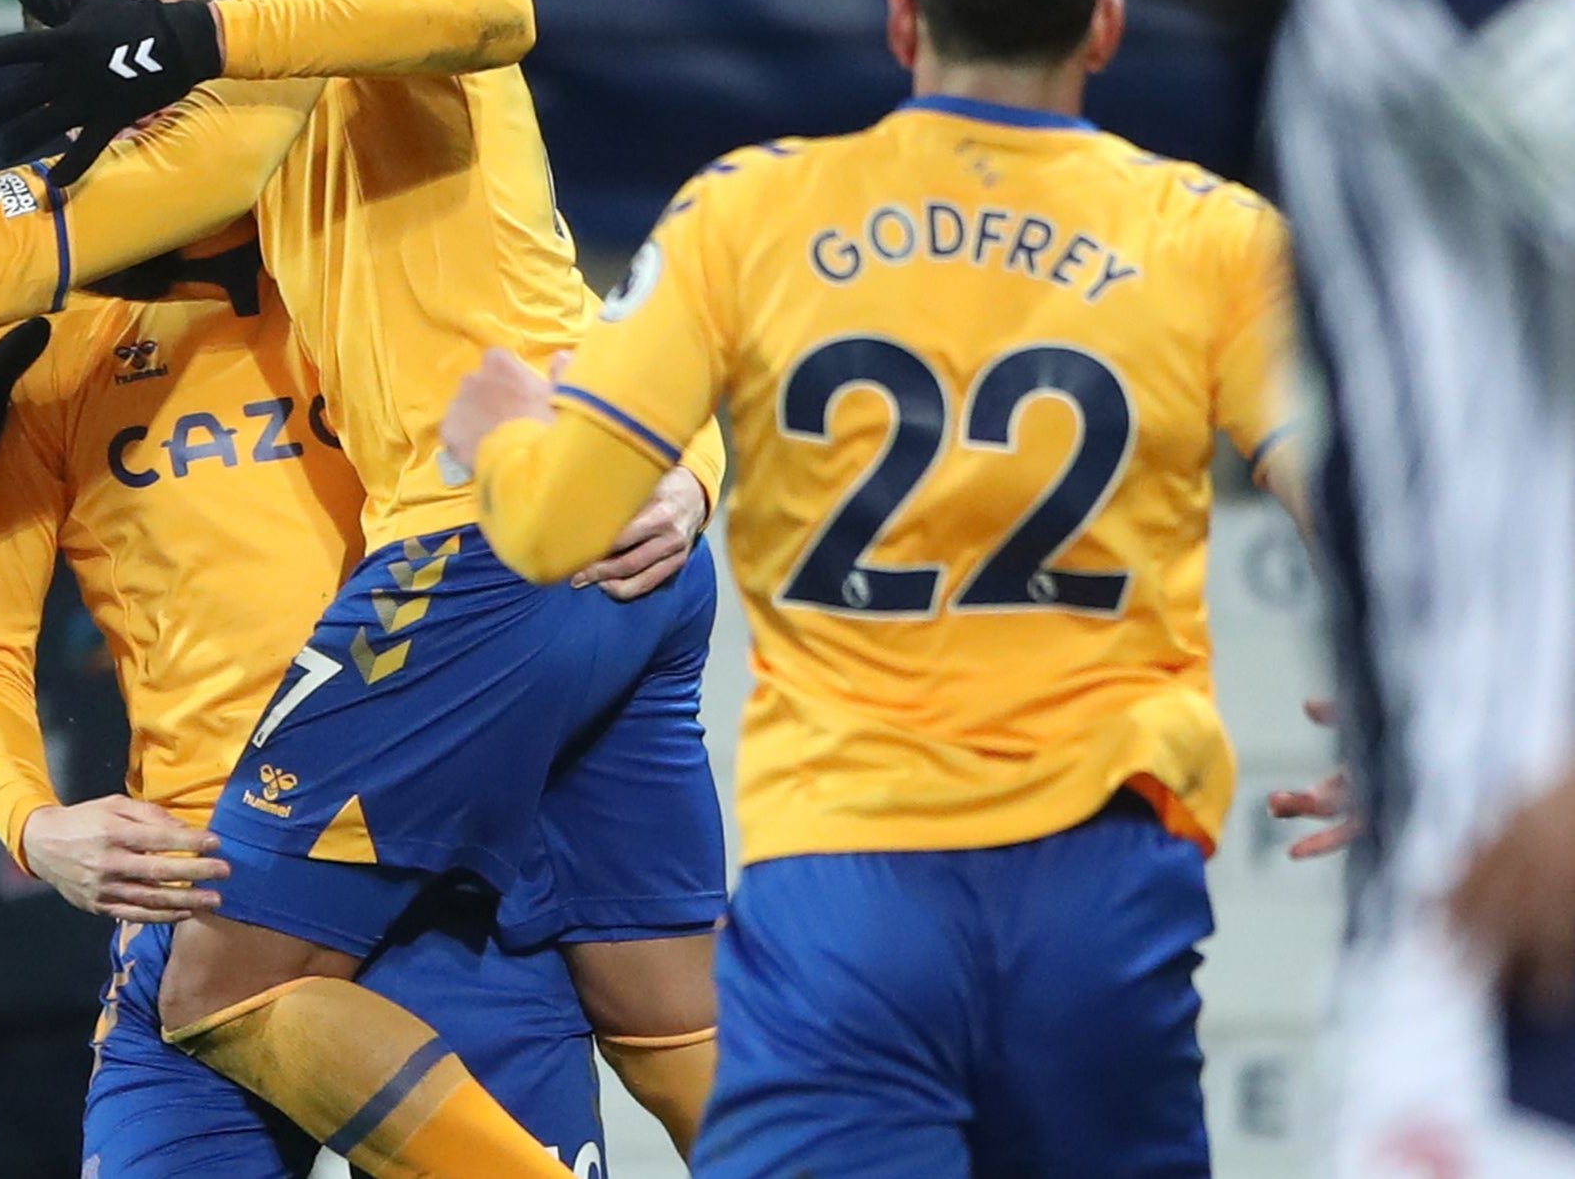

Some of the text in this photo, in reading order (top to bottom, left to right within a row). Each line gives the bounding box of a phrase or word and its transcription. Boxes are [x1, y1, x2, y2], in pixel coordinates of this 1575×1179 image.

[810, 200, 1139, 303] GODFREY
[778, 333, 1136, 619] 22
[252, 646, 343, 749] 7
[243, 789, 292, 818] hummel
